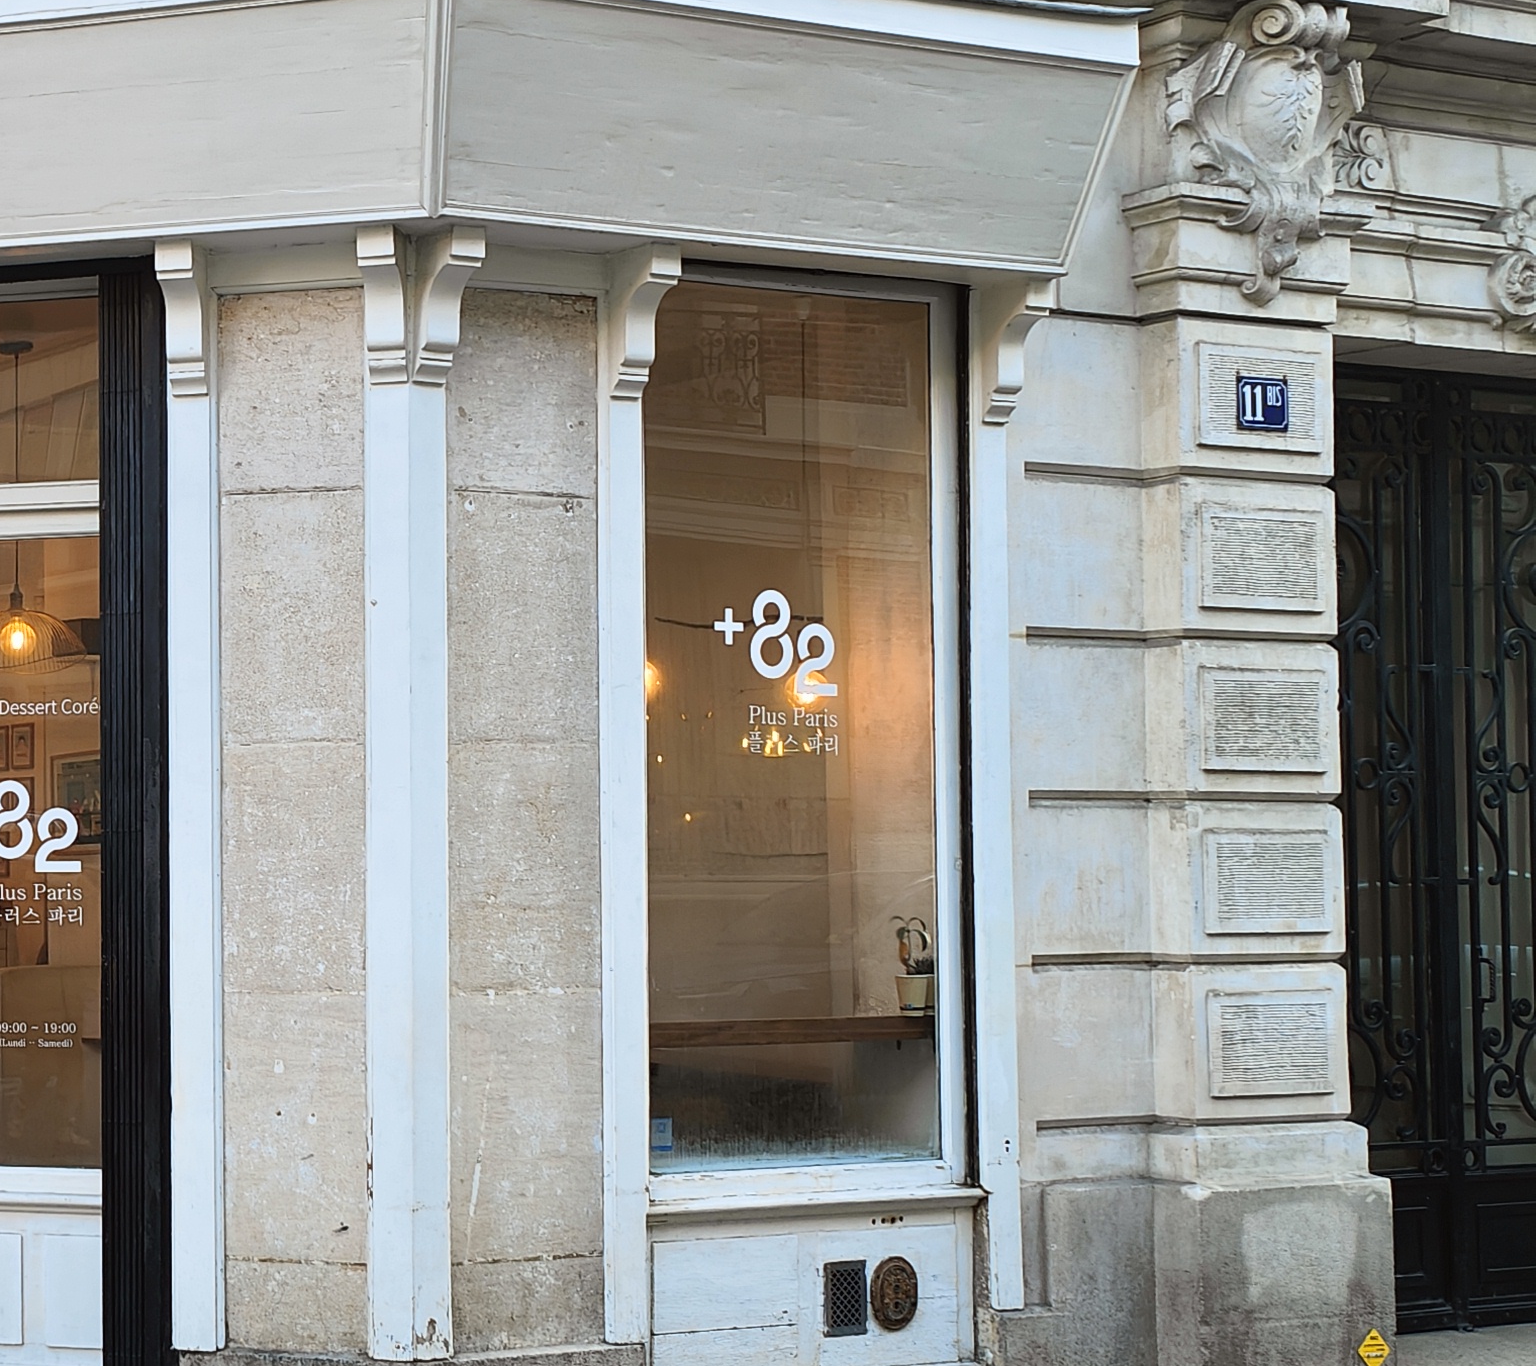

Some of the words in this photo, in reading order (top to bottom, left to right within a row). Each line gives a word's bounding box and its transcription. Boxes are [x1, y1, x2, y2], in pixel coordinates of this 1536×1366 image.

[1242, 384, 1265, 422] 11
[1266, 385, 1282, 407] BIS
[714, 589, 838, 697] +82
[60, 697, 101, 715] Coré
[749, 704, 786, 726] Plus
[793, 706, 839, 728] Paris
[807, 734, 839, 757] 파리
[33, 883, 83, 901] Paris
[47, 906, 84, 926] 파리
[44, 1022, 77, 1034] 19:00
[37, 1038, 73, 1048] Samedi)
